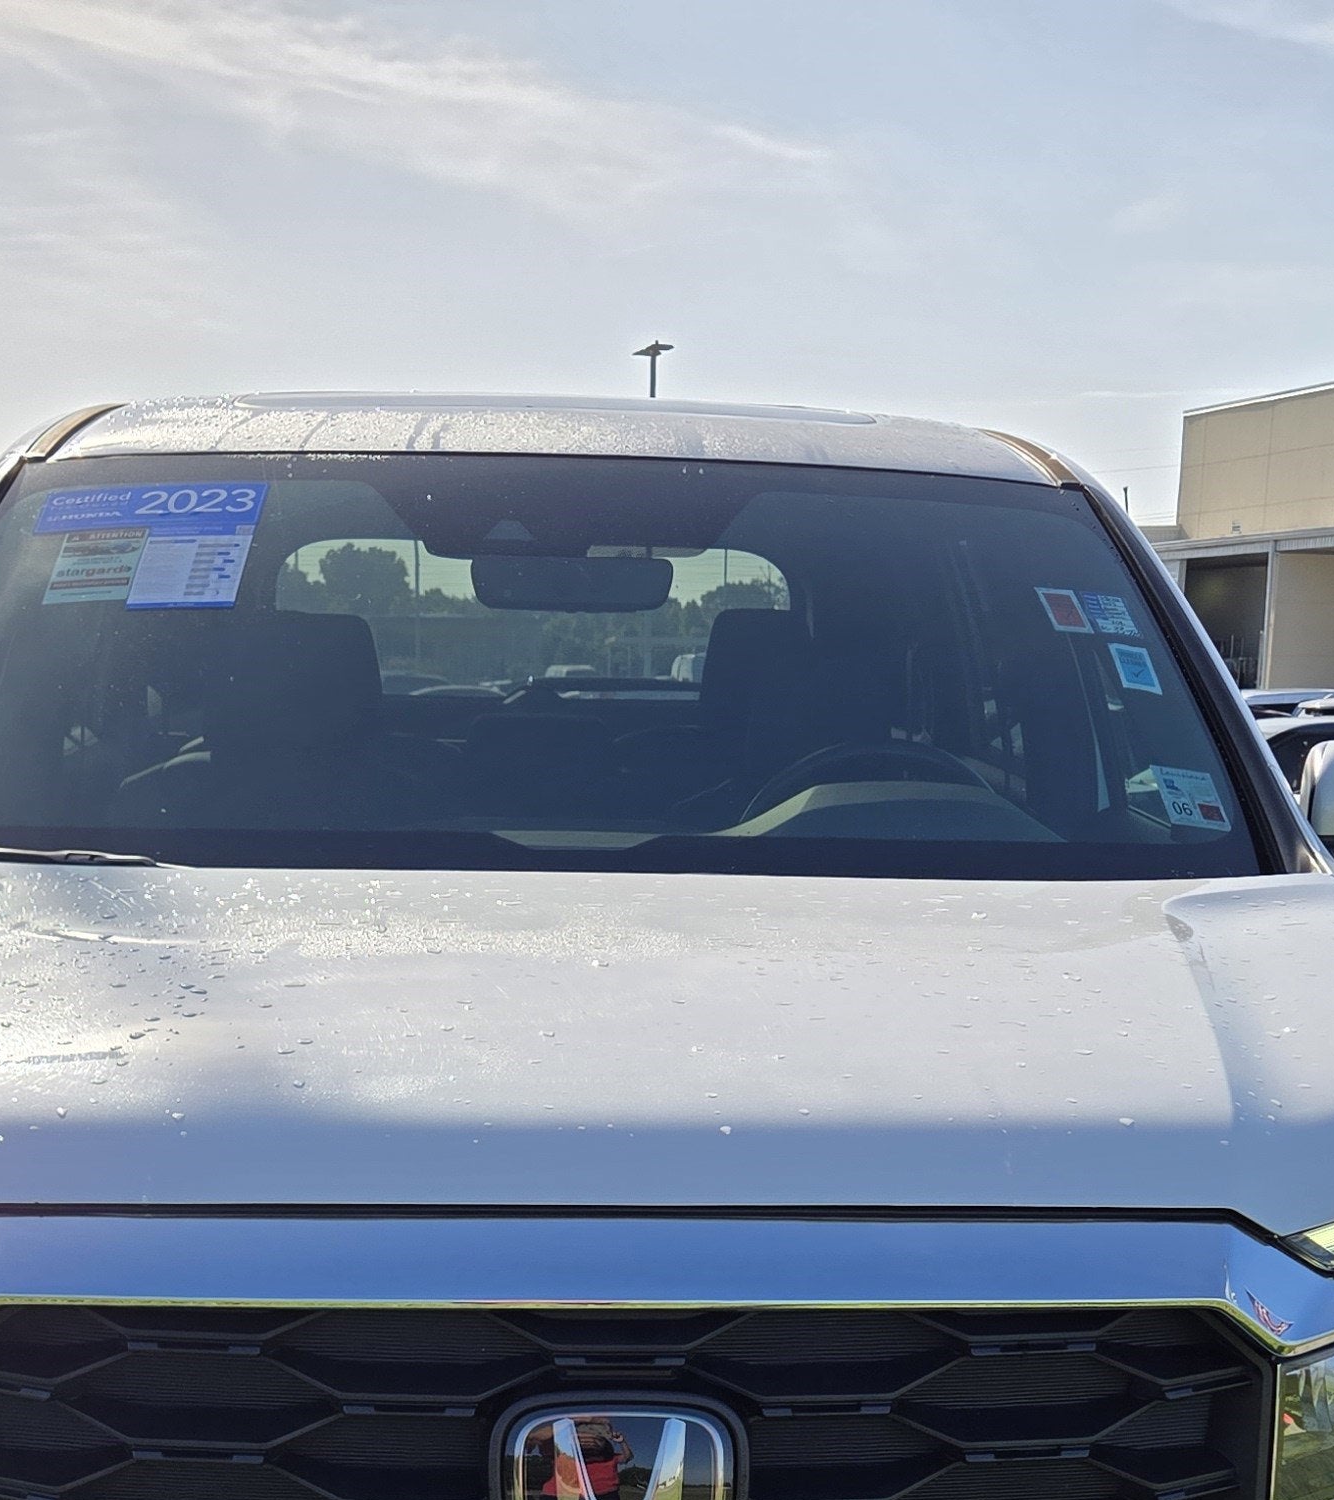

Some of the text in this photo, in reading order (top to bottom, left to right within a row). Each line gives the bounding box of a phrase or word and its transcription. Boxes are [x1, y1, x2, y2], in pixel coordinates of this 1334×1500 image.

[134, 487, 258, 515] 2023
[88, 530, 144, 541] ATTENTION
[1172, 801, 1193, 817] 06
